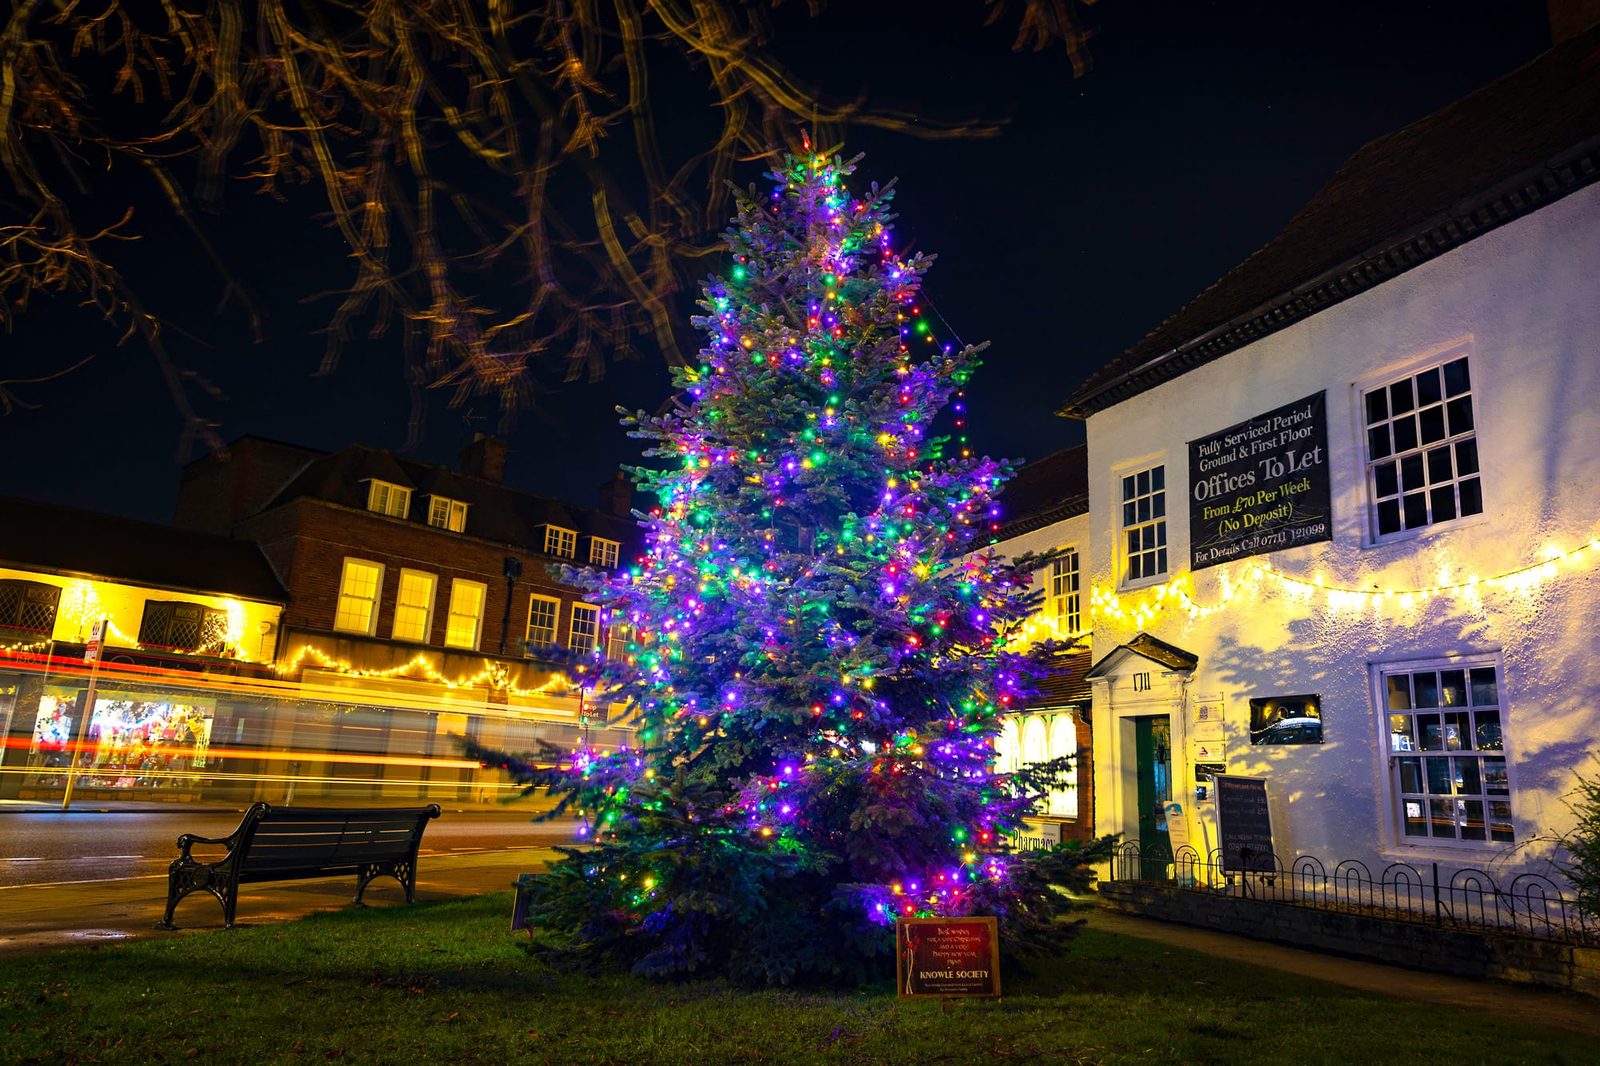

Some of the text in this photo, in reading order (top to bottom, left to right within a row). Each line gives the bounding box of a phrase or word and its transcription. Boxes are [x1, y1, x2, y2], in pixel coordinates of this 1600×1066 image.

[1198, 405, 1312, 458] Fully Serviced Period
[1199, 425, 1314, 472] Ground & First Floor
[1194, 445, 1323, 501] Offices To Let
[1203, 477, 1312, 520] From £70 Per Week
[1218, 502, 1293, 538] (No Deposit)
[1195, 552, 1208, 563] For
[1209, 543, 1240, 560] Details
[1241, 537, 1260, 551] Call
[1133, 672, 1151, 692] 1711
[1013, 829, 1056, 851] Pharmacy
[920, 970, 989, 979] KNOWLE SOCIETY
